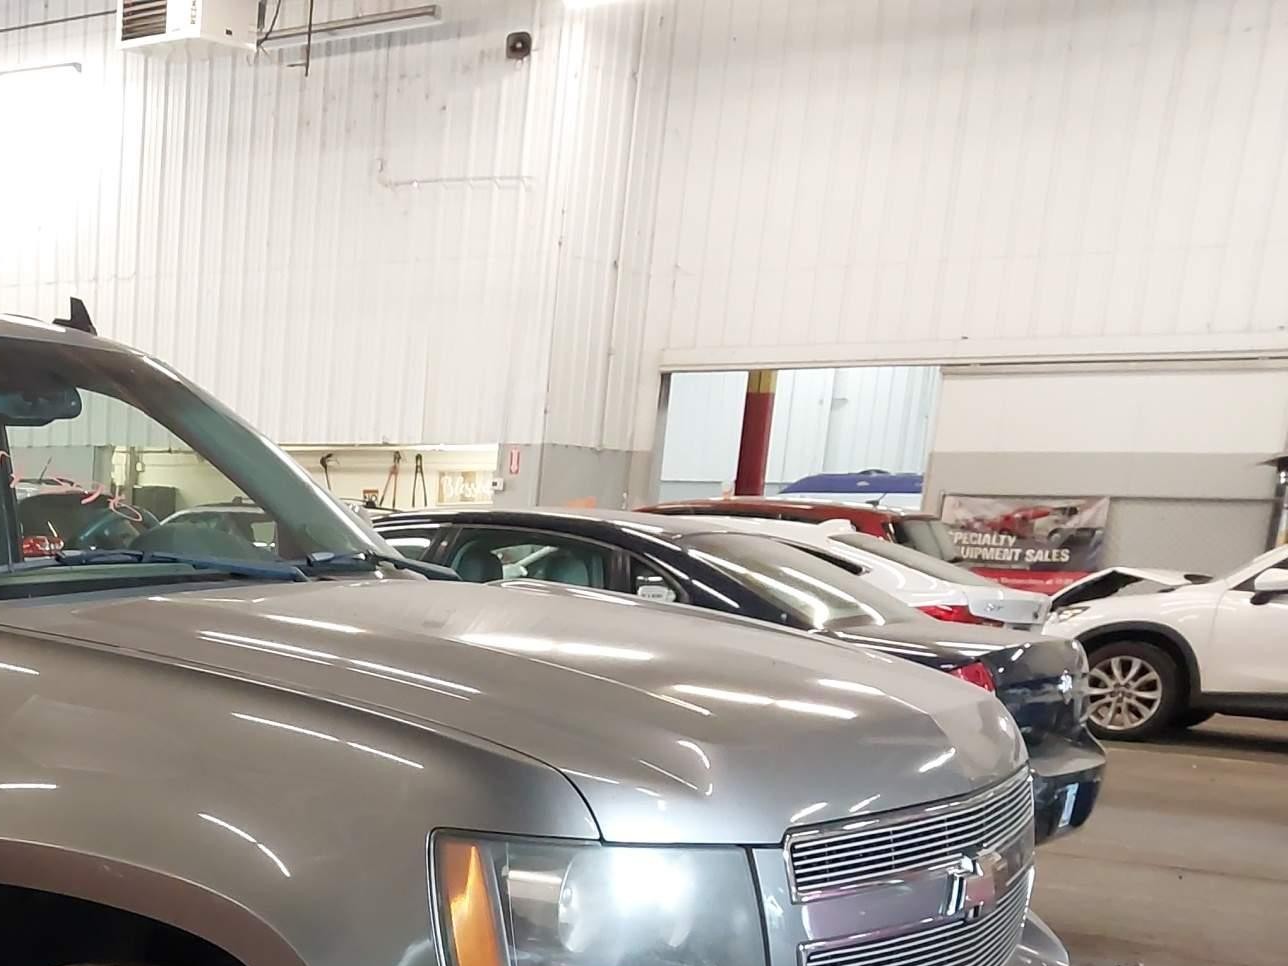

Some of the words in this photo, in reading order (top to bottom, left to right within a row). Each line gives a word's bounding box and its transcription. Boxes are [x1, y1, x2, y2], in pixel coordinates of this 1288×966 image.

[949, 531, 1017, 547] PECIALTY
[959, 547, 1020, 562] UIPMENT
[1025, 548, 1070, 562] SALES
